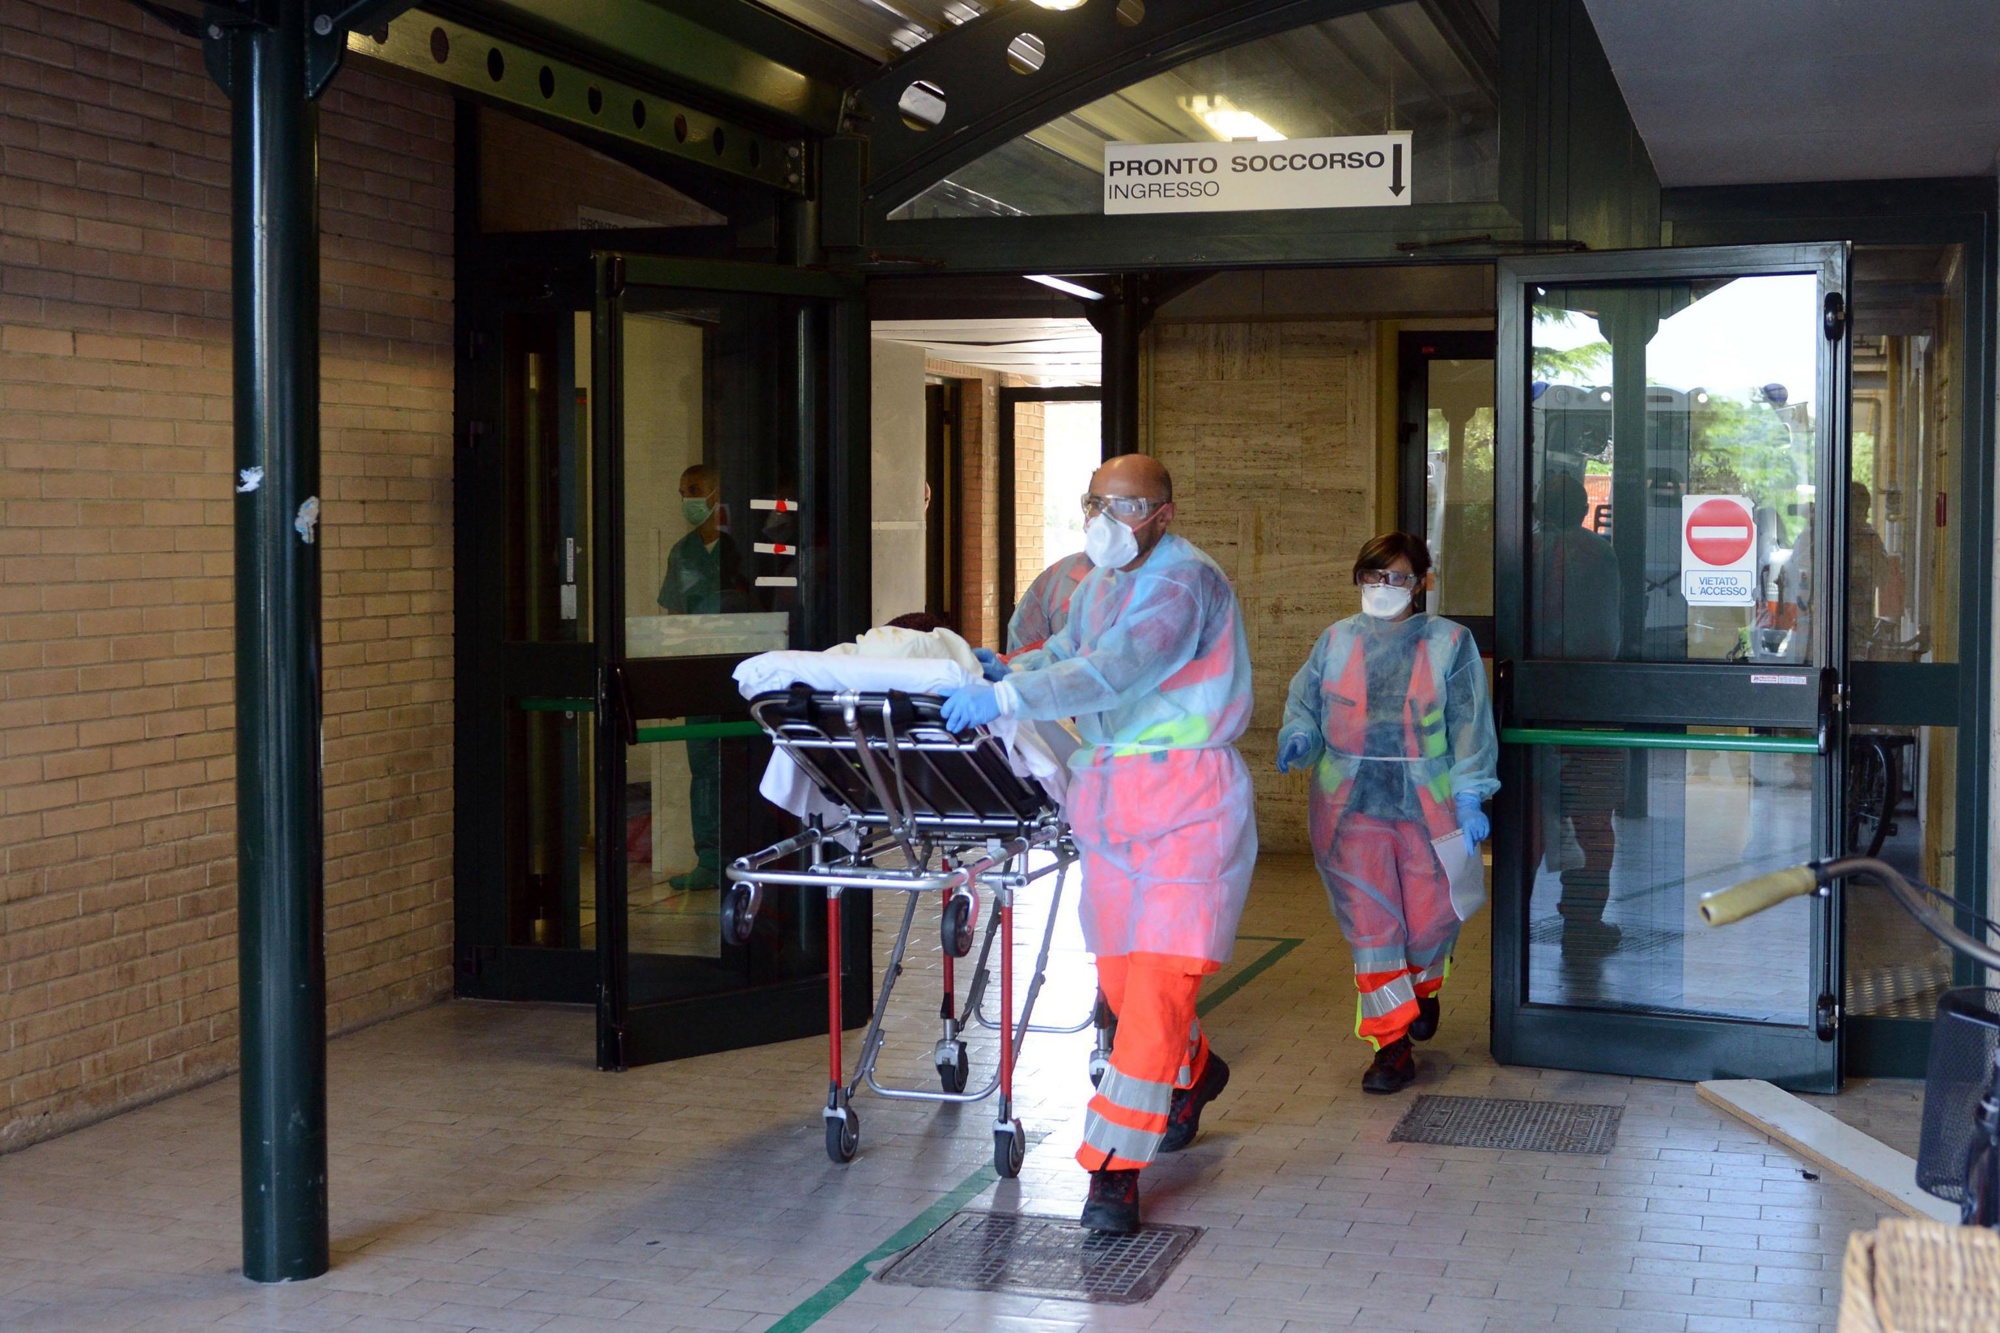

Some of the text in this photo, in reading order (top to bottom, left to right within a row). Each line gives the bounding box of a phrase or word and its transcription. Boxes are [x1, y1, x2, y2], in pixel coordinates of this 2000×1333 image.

[1109, 151, 1385, 176] PRONTO SOCCORSO
[1109, 181, 1220, 199] INGRESSO
[1699, 577, 1738, 586] VIETATO
